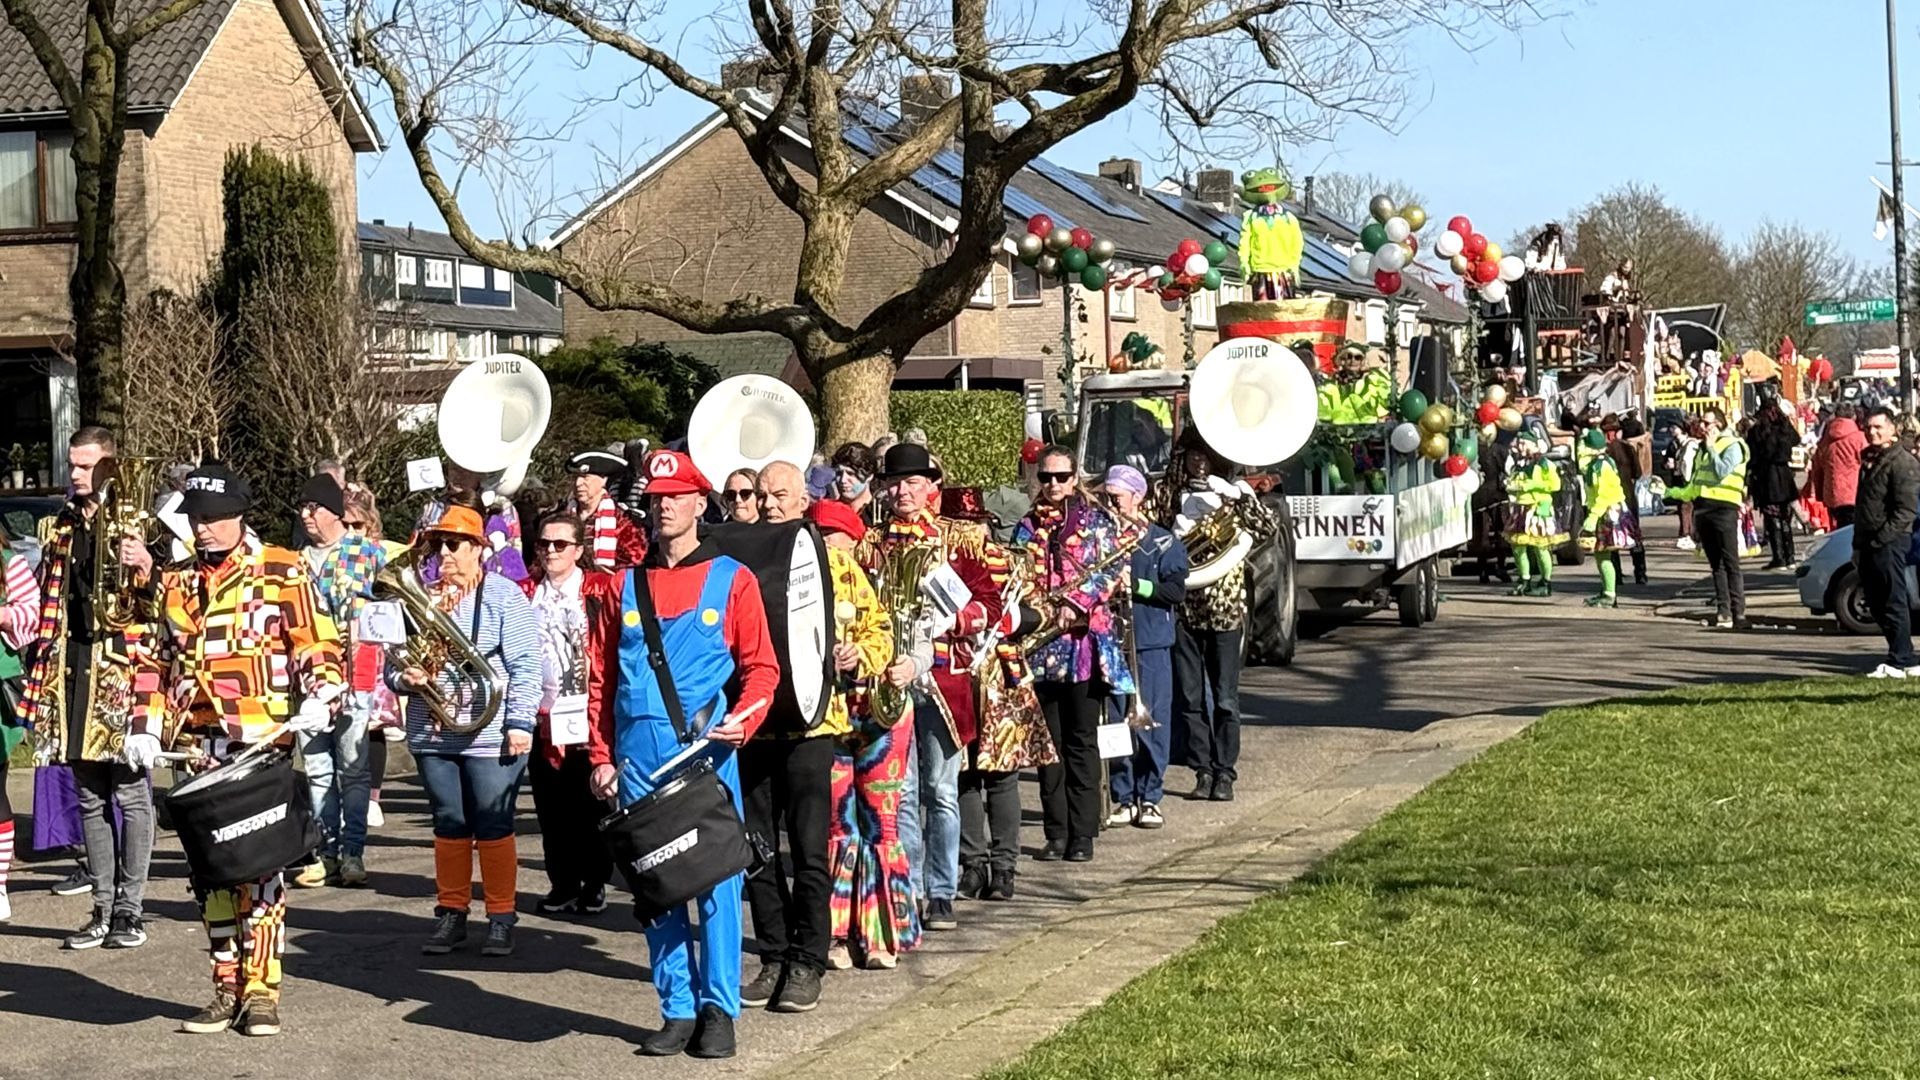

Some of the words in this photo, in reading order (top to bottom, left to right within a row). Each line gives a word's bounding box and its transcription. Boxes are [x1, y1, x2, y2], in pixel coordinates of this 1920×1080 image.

[1837, 311, 1875, 323] STRAAT
[484, 361, 521, 374] JUPITER
[653, 457, 674, 473] M
[631, 833, 692, 874] Vancore
